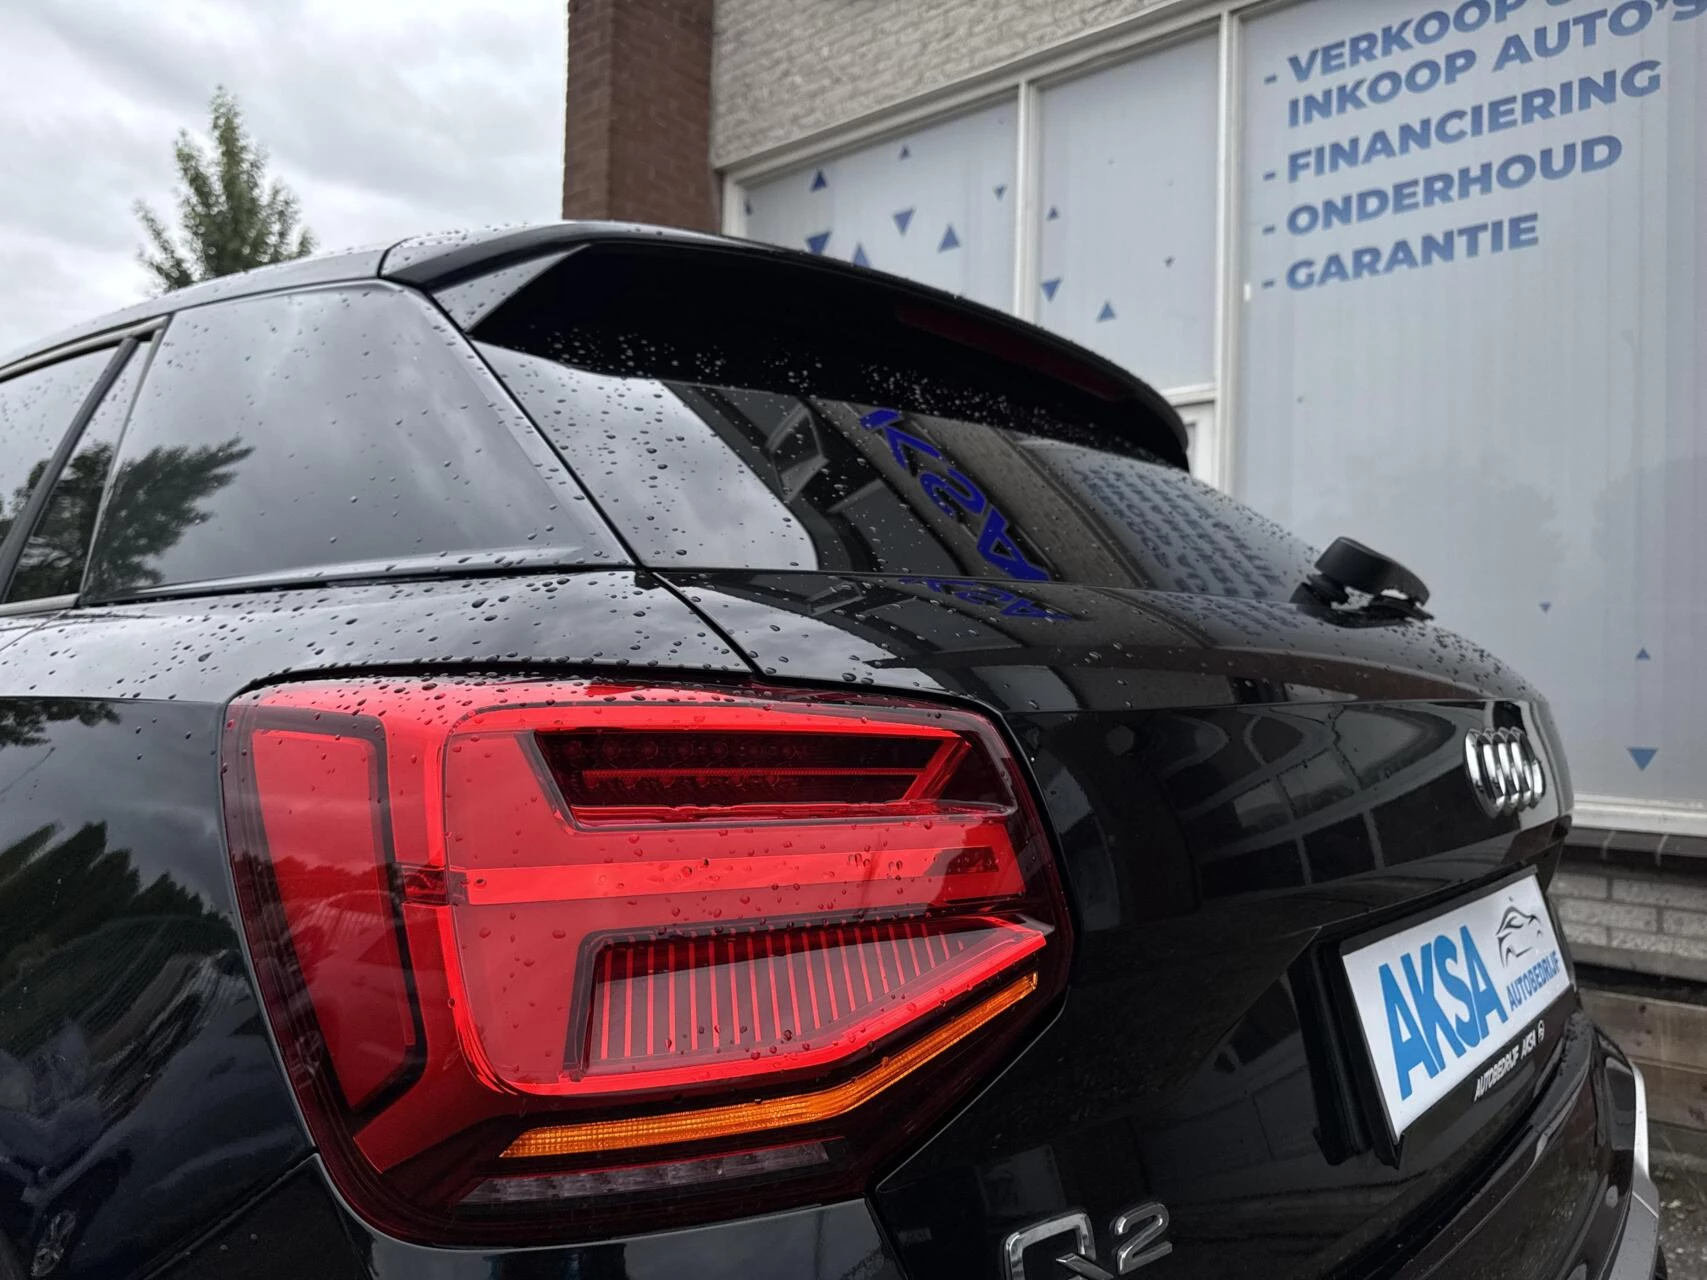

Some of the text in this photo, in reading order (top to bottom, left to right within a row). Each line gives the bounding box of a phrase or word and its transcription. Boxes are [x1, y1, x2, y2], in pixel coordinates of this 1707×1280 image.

[1287, 0, 1527, 83] VERKOOP
[1287, 49, 1477, 128] INKOOP
[1287, 60, 1662, 183] FINANCIERING
[1286, 135, 1623, 237] ONDERHOUD
[1285, 213, 1540, 291] GARANTIE
[1378, 924, 1508, 1101] AKSA
[1506, 950, 1560, 1011] AUTOBEDRIJF
[1004, 1202, 1173, 1280] Q2
